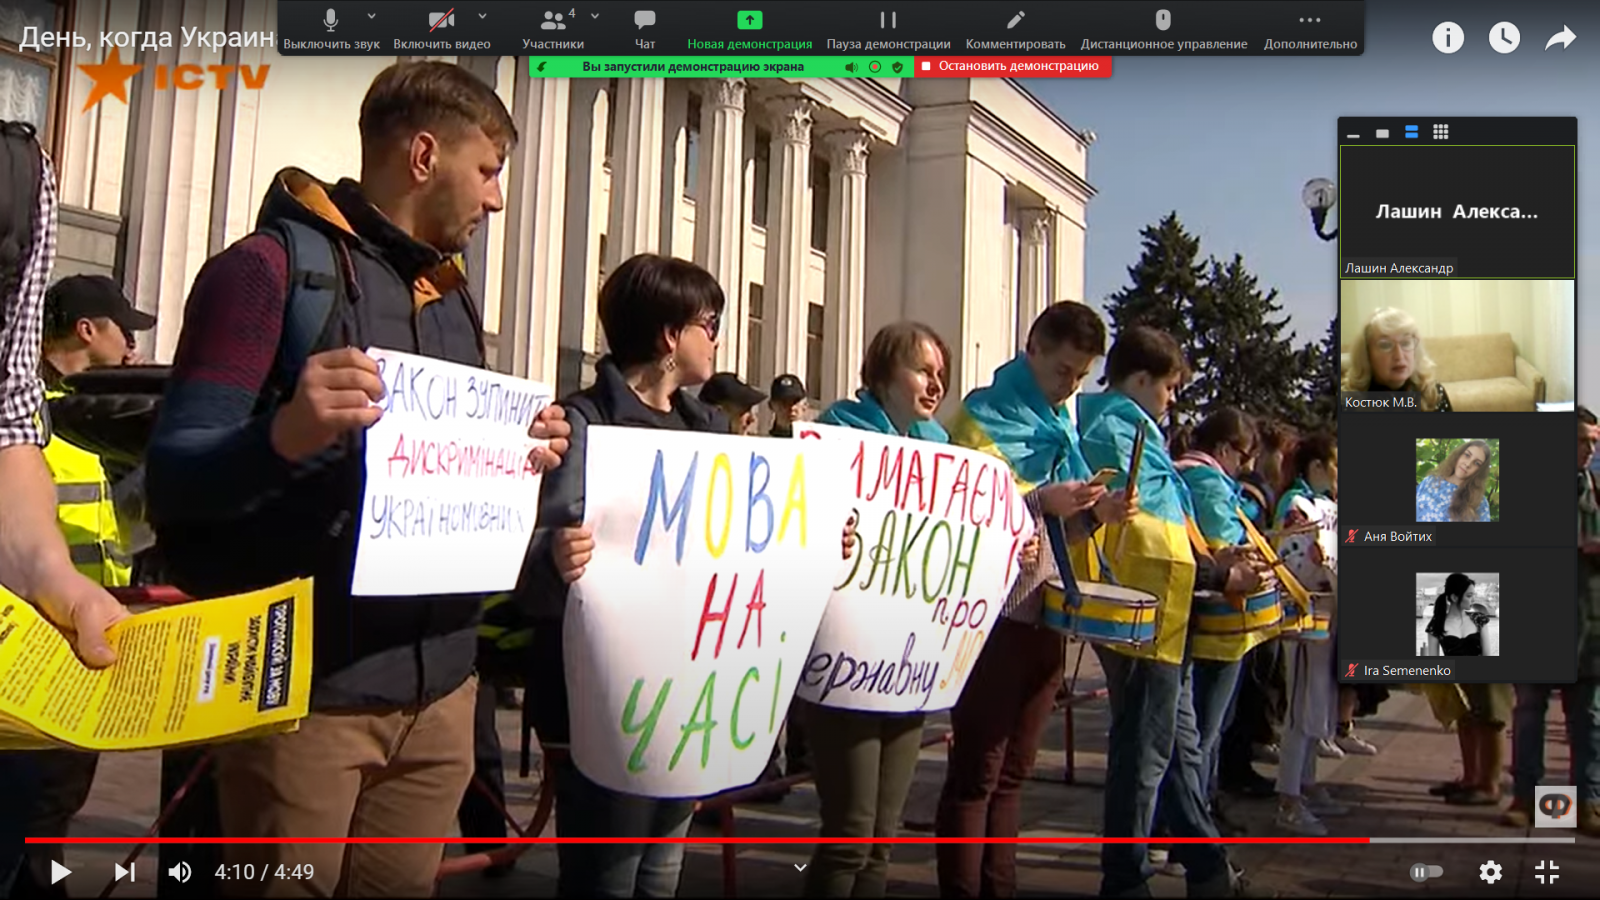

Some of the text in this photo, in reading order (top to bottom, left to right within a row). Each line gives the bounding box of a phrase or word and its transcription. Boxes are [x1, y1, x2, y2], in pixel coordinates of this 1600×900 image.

[634, 449, 807, 566] МОВА
[800, 430, 1026, 537] МАГАЄМО
[833, 508, 981, 604] ЗАКОН
[691, 568, 767, 661] НА
[931, 597, 988, 652] про
[620, 631, 788, 774] ЧАСІ
[802, 632, 940, 710] ержавну
